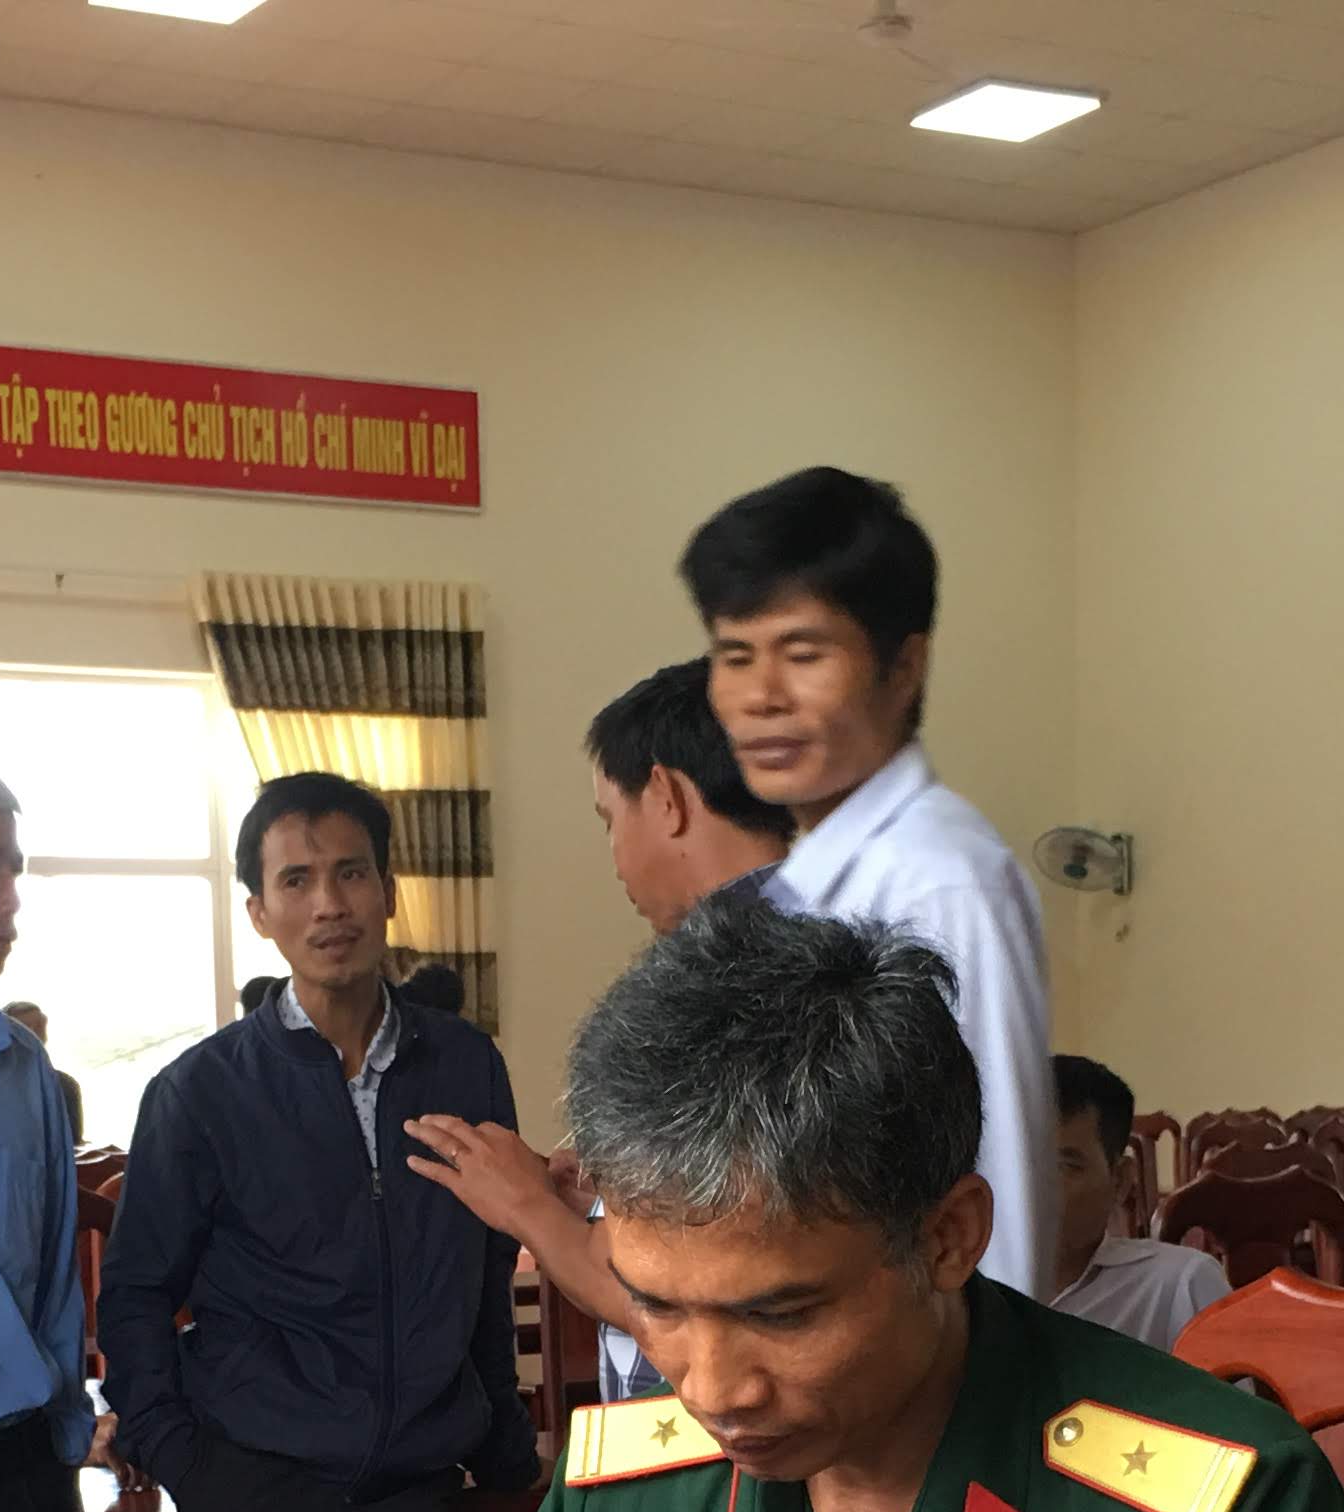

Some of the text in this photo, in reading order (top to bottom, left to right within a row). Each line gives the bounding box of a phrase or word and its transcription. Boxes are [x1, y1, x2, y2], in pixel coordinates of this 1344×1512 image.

[45, 388, 100, 450] THEO
[106, 391, 178, 457] GƯƠNG
[183, 384, 225, 461] CHỦ
[229, 405, 276, 476] TỊCH
[280, 392, 308, 468] HỒ
[313, 403, 348, 471] CHÍ
[352, 416, 405, 475] MINH
[409, 410, 429, 477] VĨ
[433, 424, 466, 492] ĐẠI
